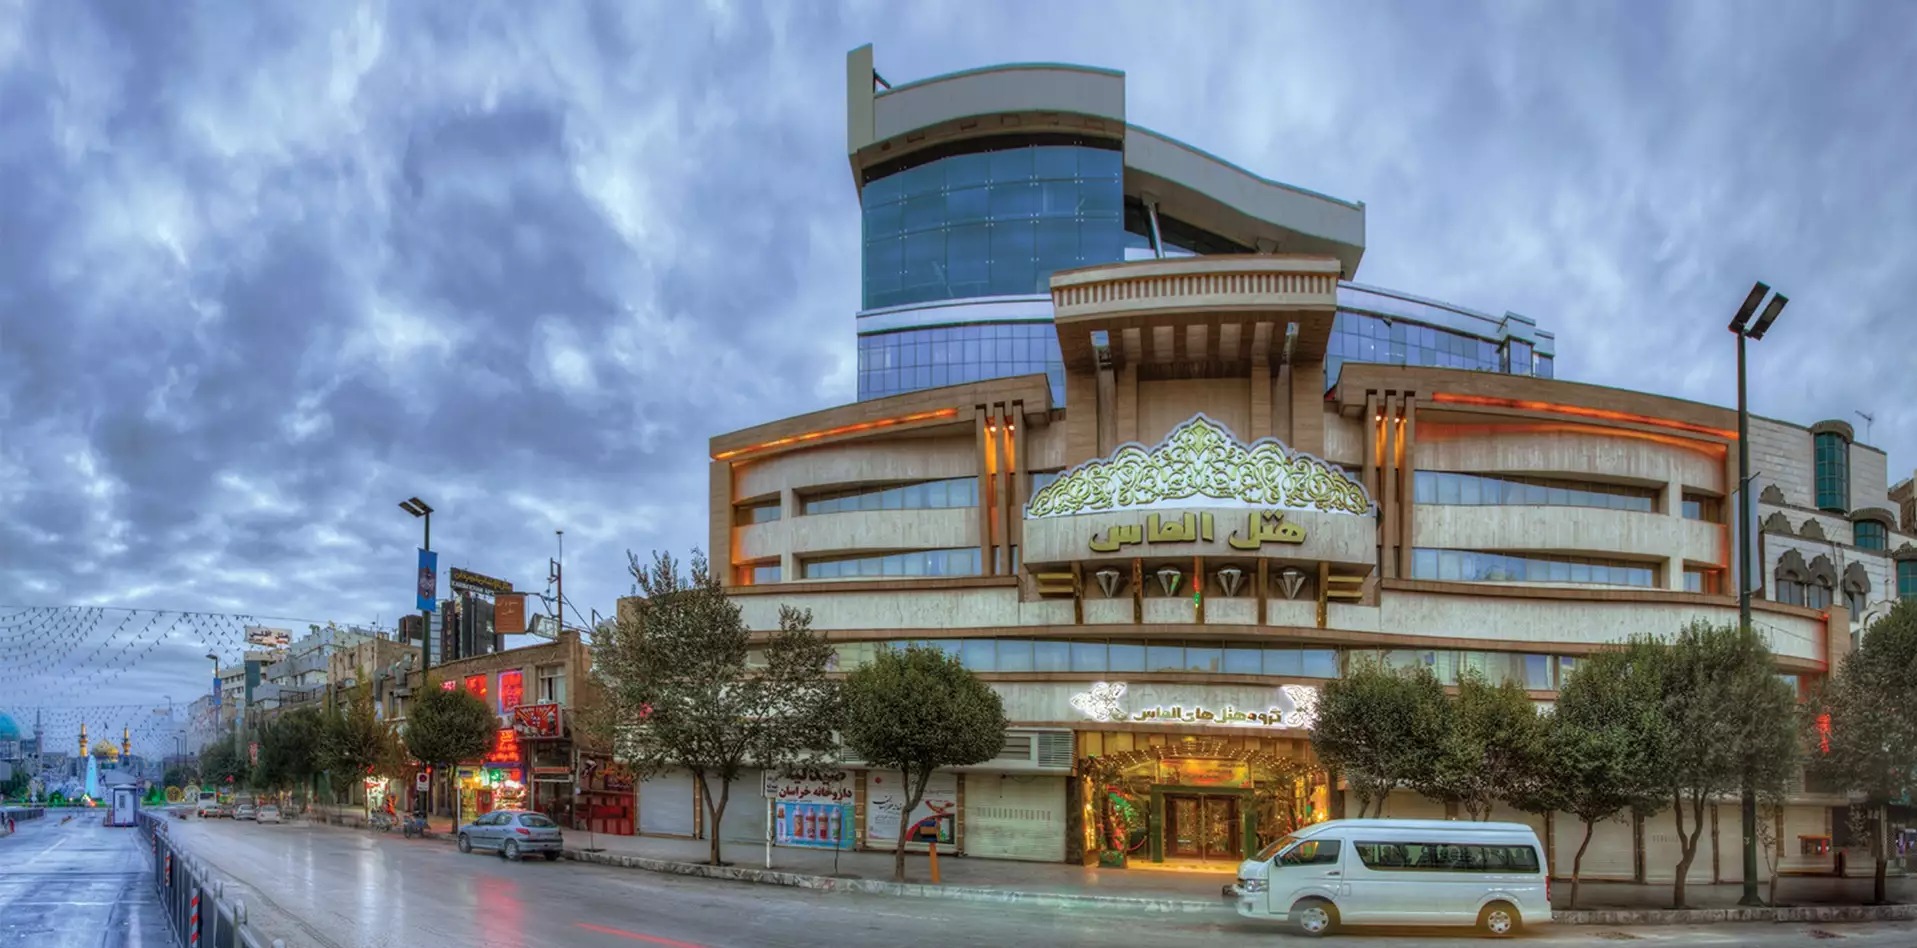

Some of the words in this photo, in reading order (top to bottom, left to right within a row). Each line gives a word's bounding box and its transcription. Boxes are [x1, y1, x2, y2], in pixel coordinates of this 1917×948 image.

[1089, 511, 1215, 551] الماس
[1228, 509, 1307, 550] هتل
[1133, 706, 1181, 721] الماس
[1181, 707, 1214, 722] های
[1214, 706, 1246, 723] هتل
[779, 785, 811, 799] خراسان
[813, 786, 853, 801] داروخانه
